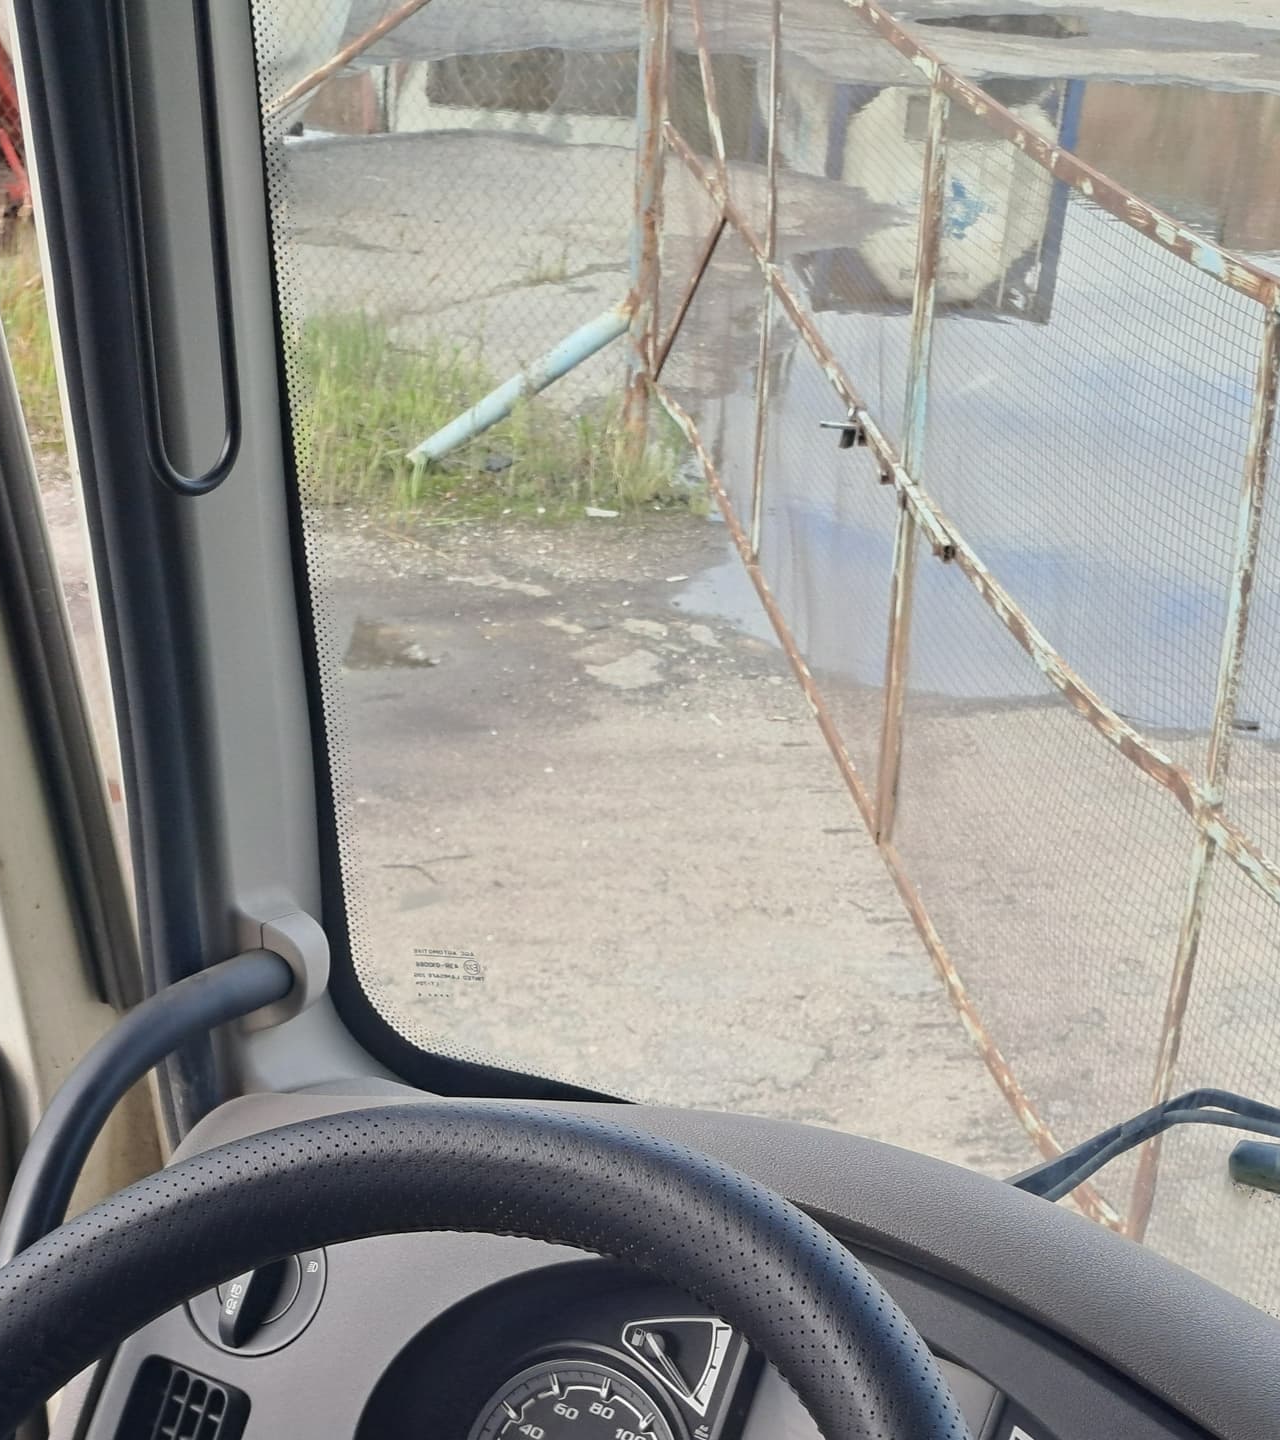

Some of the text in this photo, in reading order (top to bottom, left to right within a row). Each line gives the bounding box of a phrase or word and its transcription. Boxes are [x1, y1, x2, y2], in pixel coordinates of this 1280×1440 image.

[553, 1403, 579, 1420] 60
[589, 1402, 615, 1420] 80
[519, 1424, 544, 1440] 40
